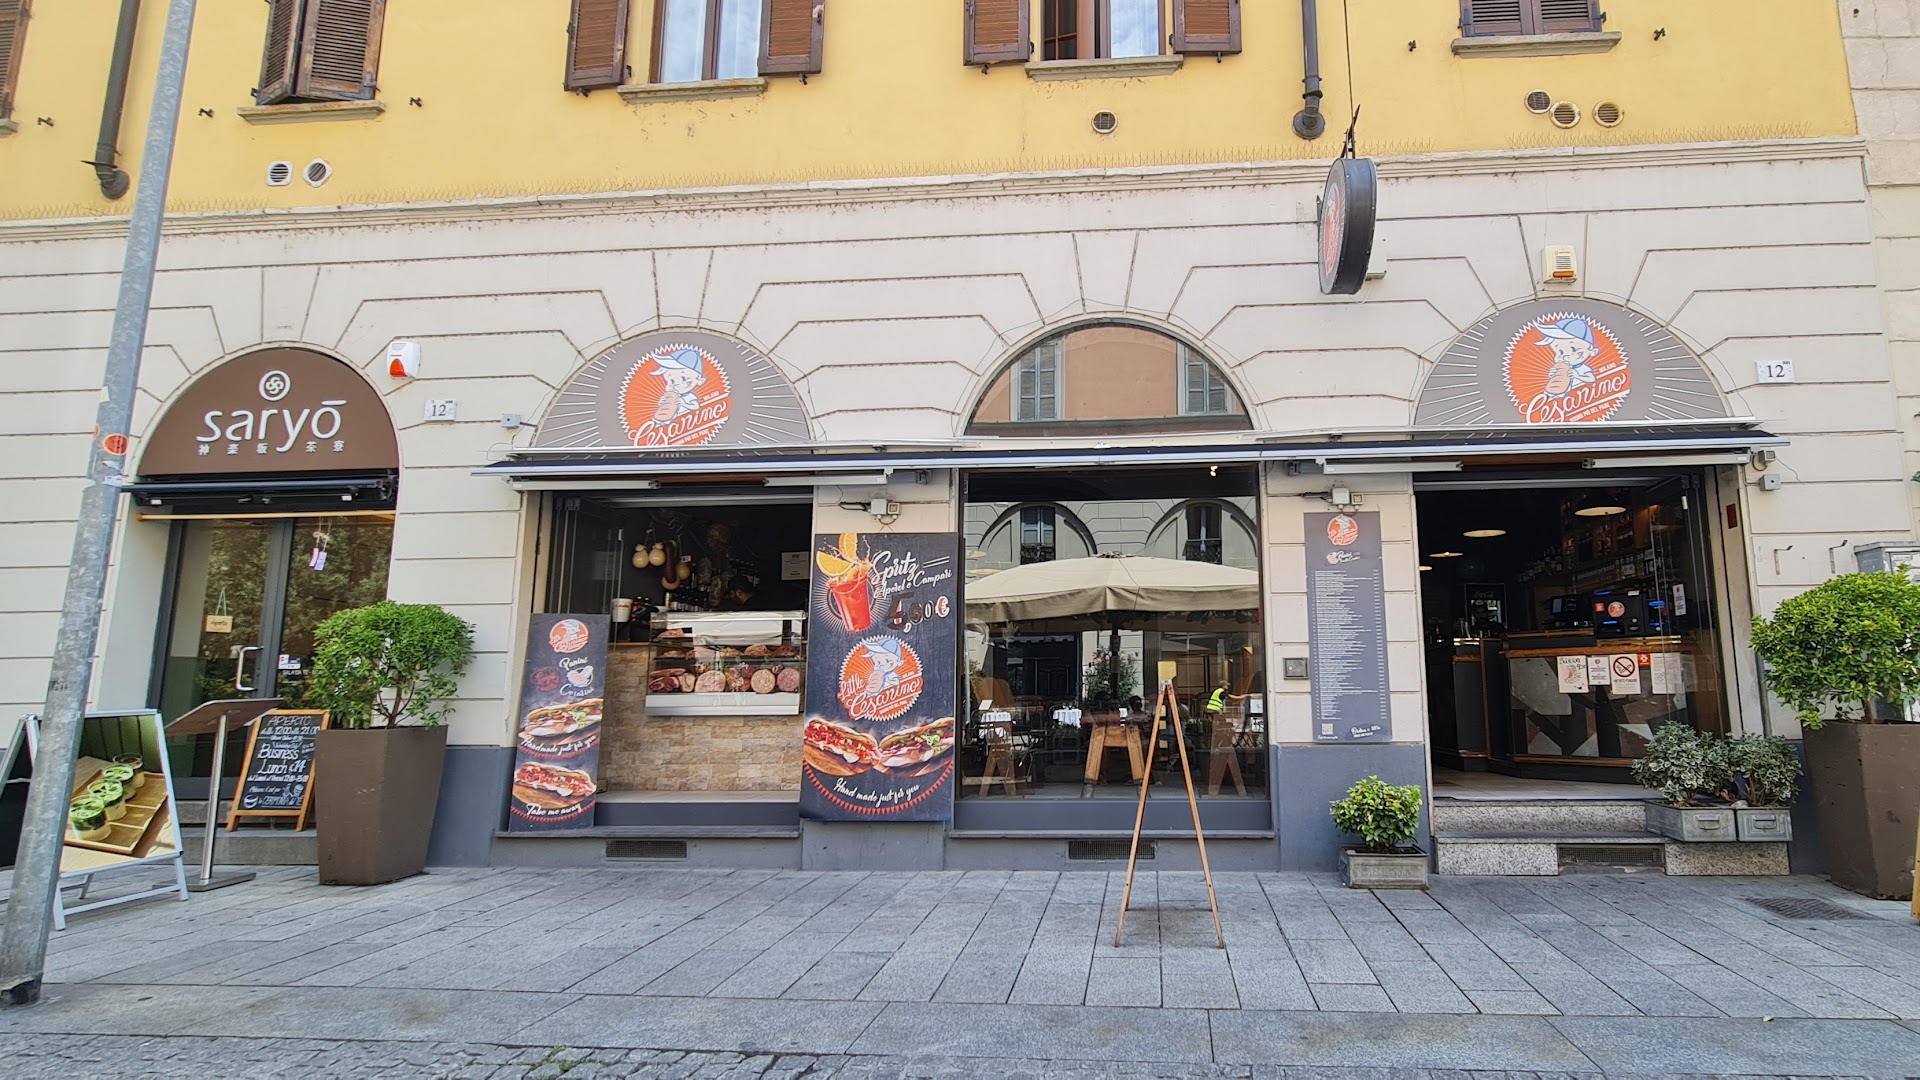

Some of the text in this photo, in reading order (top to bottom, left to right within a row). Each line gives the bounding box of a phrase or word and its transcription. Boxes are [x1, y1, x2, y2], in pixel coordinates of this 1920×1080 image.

[1766, 364, 1785, 378] 12
[431, 404, 447, 417] 12
[1518, 372, 1627, 423] Cesarino
[196, 400, 347, 452] saryō
[627, 401, 727, 446] Cesarino
[871, 550, 919, 585] Spritz
[873, 579, 906, 600] Aperol
[913, 569, 952, 588] Campari
[837, 673, 865, 700] Little
[846, 678, 921, 718] Cesarino
[267, 715, 312, 726] APERTO
[257, 743, 299, 760] Business
[519, 734, 558, 753] Handmade
[558, 743, 573, 756] just
[585, 735, 597, 749] you
[257, 758, 287, 774] Lunch
[833, 777, 858, 798] Hand
[856, 790, 878, 802] made
[876, 788, 894, 808] just
[906, 784, 920, 801] you
[525, 803, 583, 817] Take me away
